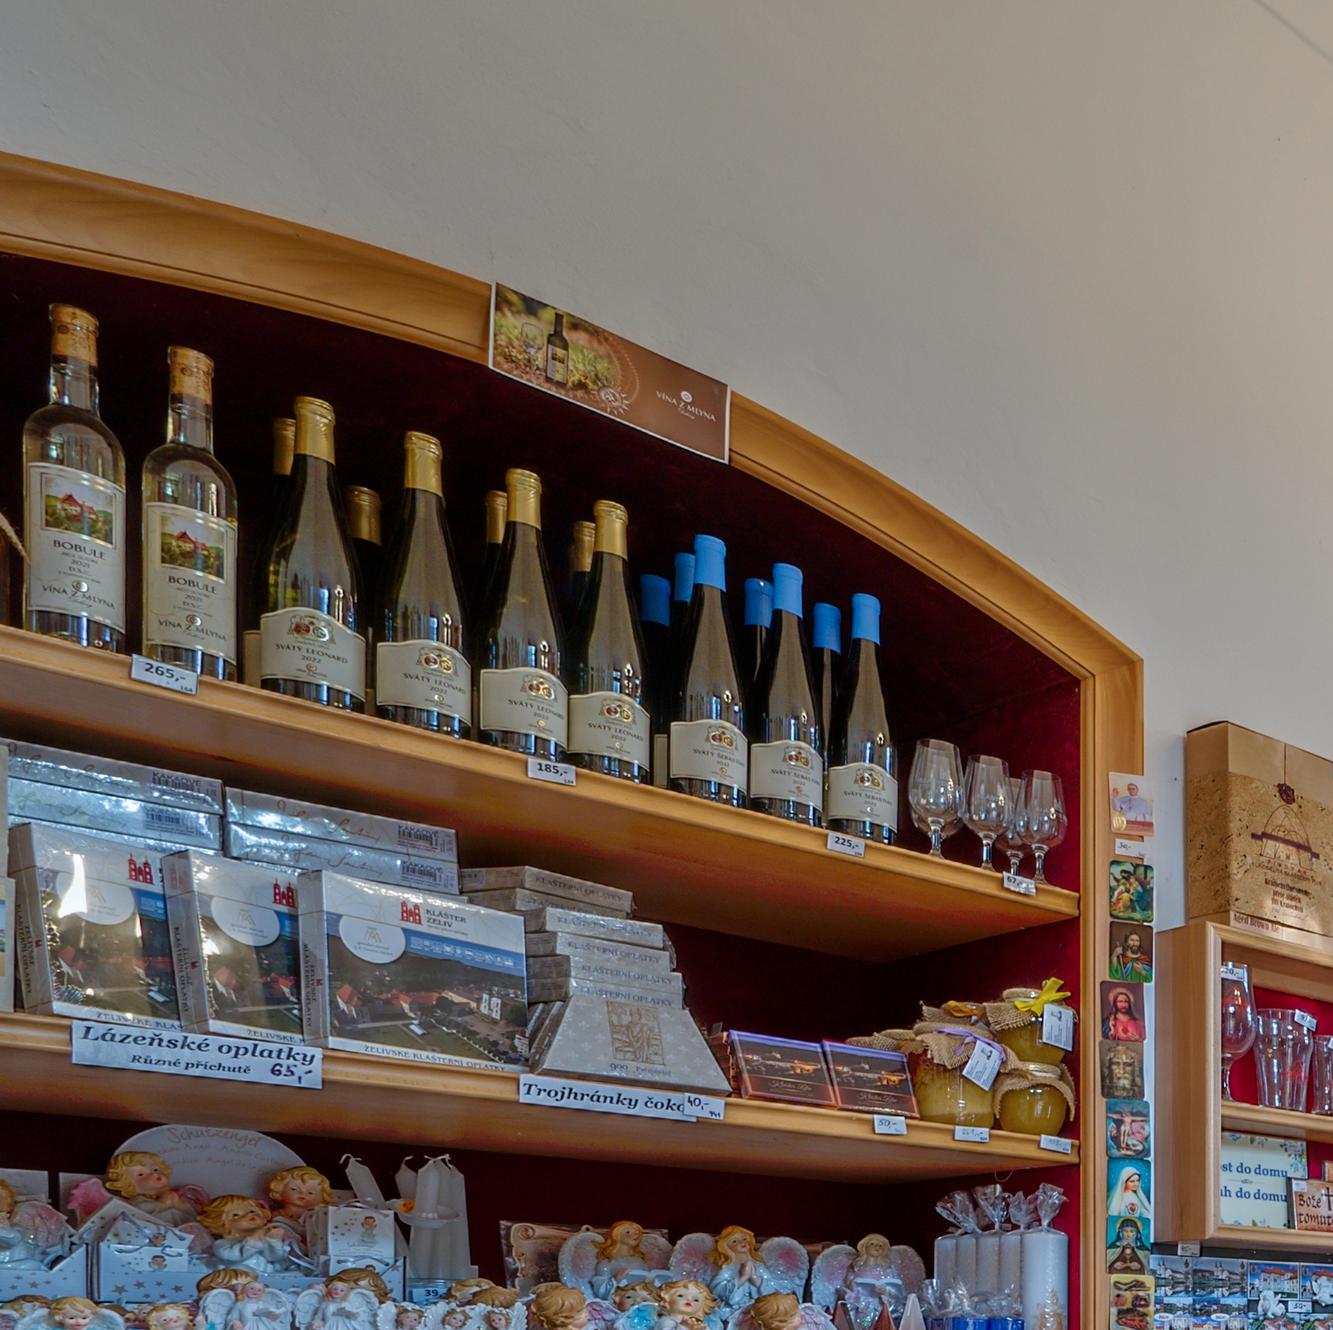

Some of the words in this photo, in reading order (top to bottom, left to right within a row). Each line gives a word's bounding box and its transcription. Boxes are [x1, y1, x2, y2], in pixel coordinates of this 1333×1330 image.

[53, 539, 106, 561] BOBULE
[168, 575, 218, 595] BOBULE
[144, 662, 186, 683] 265,-
[536, 761, 568, 777] 185,-
[834, 835, 859, 850] 225,-
[80, 1025, 211, 1052] Lázeňské
[217, 1041, 316, 1067] oplatky
[129, 1054, 182, 1068] Různé
[184, 1059, 252, 1076] příchutě
[270, 1063, 314, 1084] 65,-
[522, 1081, 640, 1110] Trojhránky
[687, 1096, 710, 1111] 40,-
[1235, 1162, 1251, 1175] do
[1253, 1163, 1288, 1178] domu
[1235, 1187, 1251, 1200] do
[1253, 1189, 1287, 1203] domu
